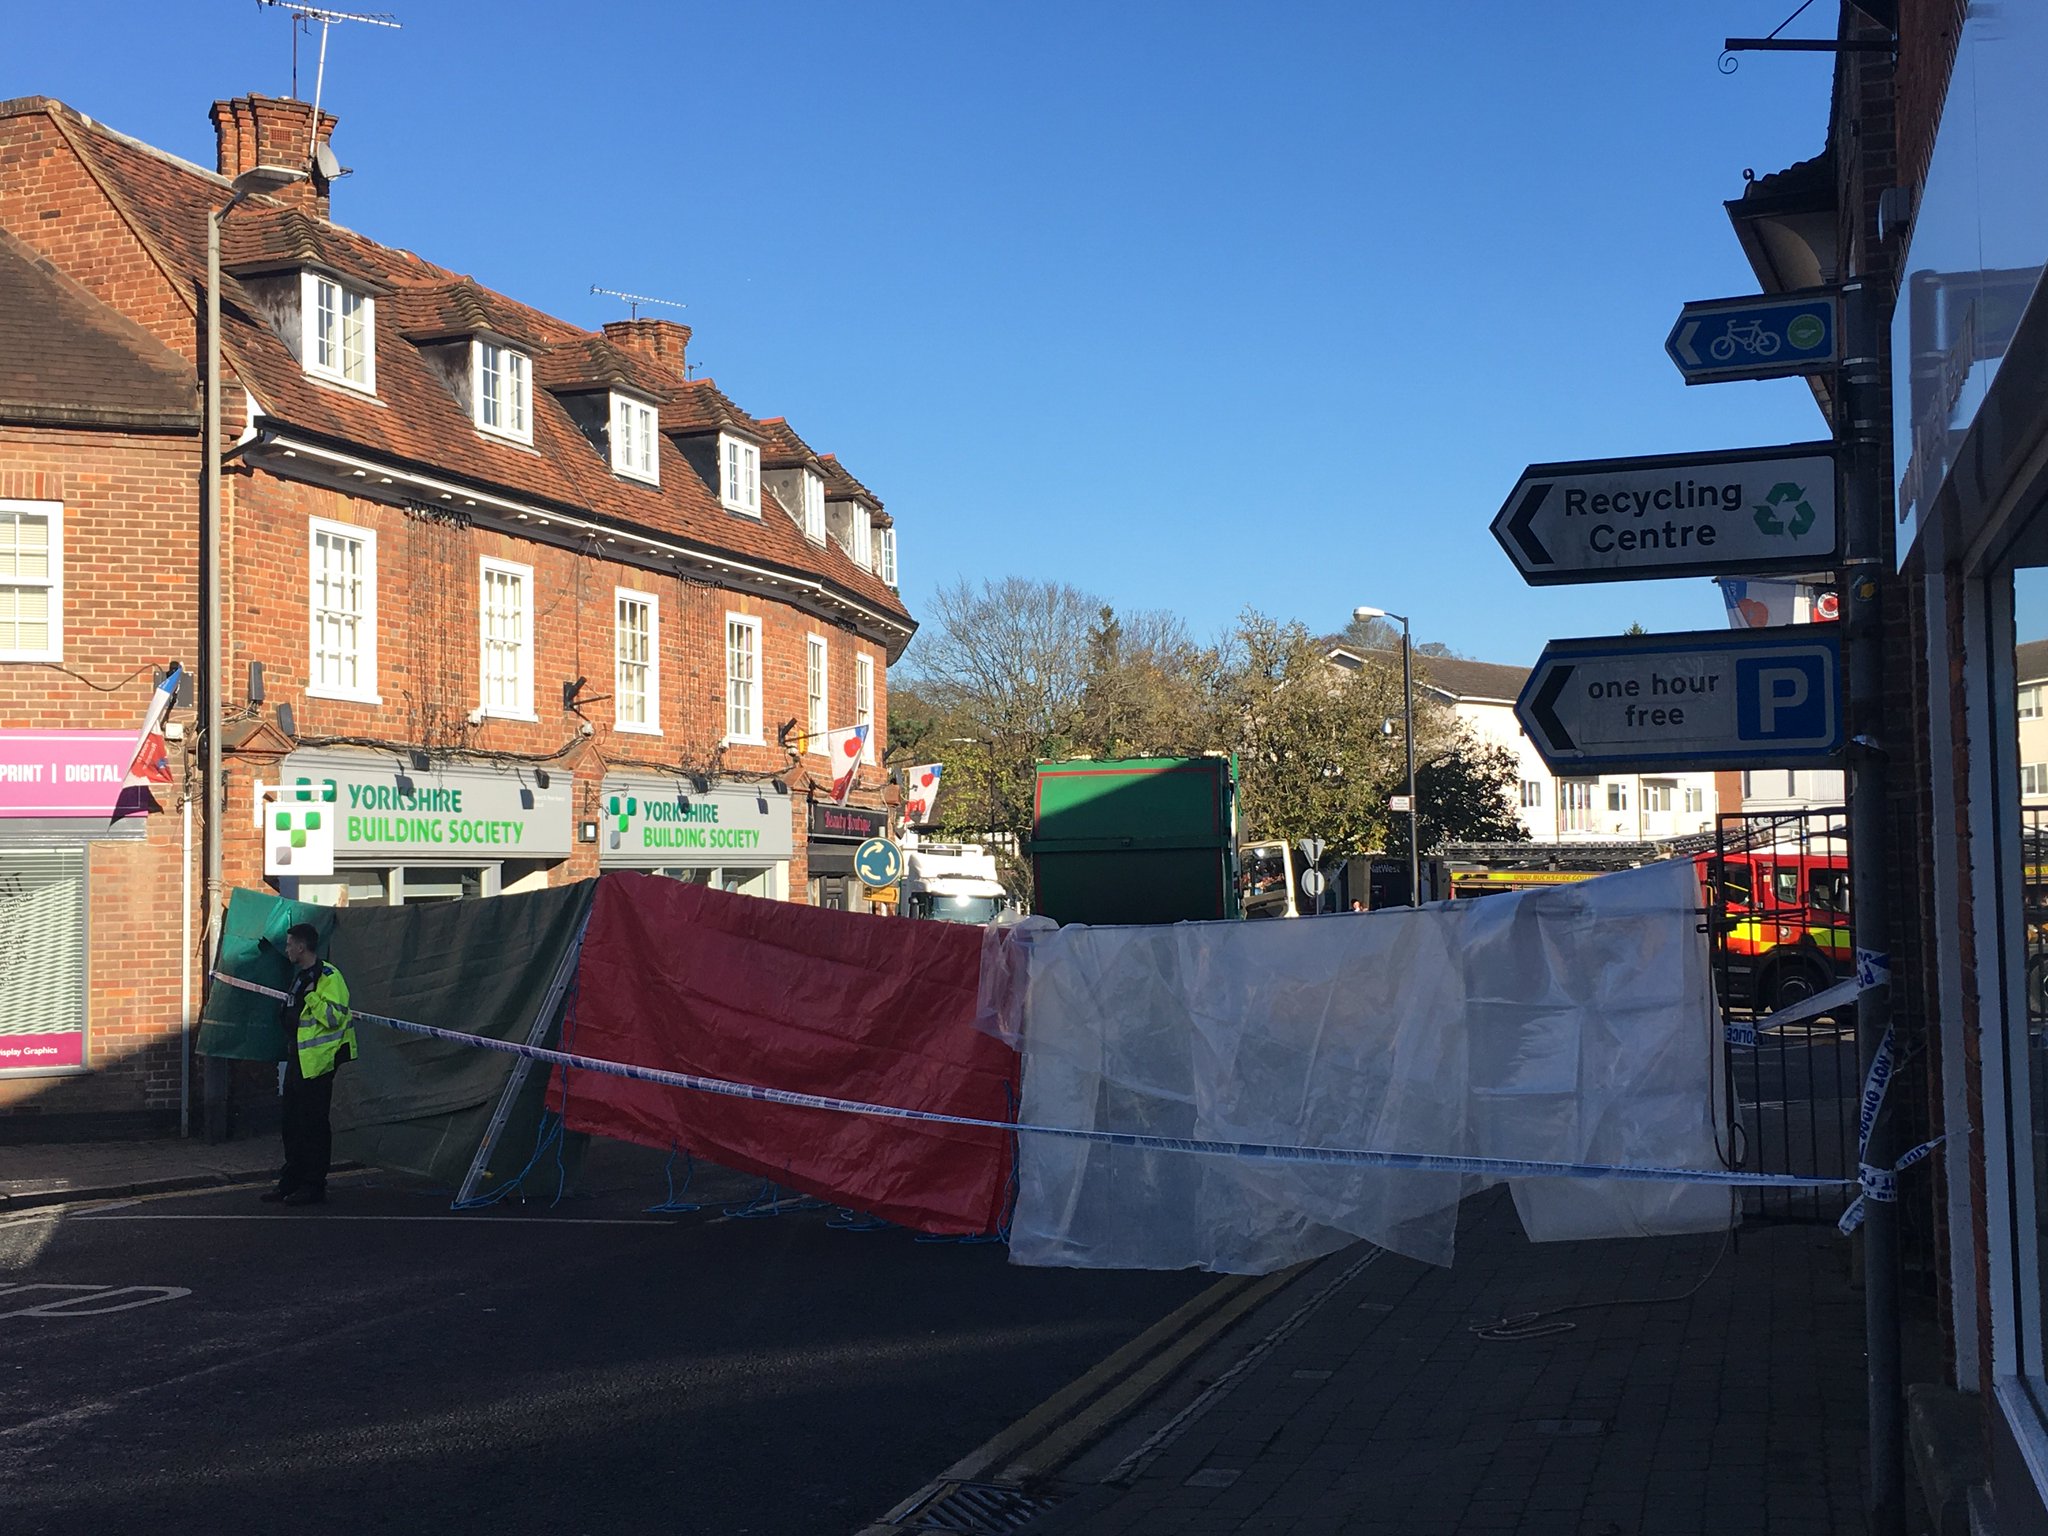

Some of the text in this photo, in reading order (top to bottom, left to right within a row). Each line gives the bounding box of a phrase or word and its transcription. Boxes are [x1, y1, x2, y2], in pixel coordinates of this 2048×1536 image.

[1564, 480, 1742, 518] Recycling
[1589, 521, 1717, 553] Centre
[1587, 673, 1720, 699] one hour
[1759, 667, 1809, 733] P
[1625, 704, 1685, 727] free
[0, 764, 123, 783] PRINT DIGITAL
[347, 783, 463, 813] YORKSHIRE
[643, 801, 719, 823] YORKSHIRE
[348, 816, 524, 844] BUILDING SOCIETY
[643, 826, 760, 848] BUILDING SOCIETY
[0, 1047, 58, 1057] isplay Graphics
